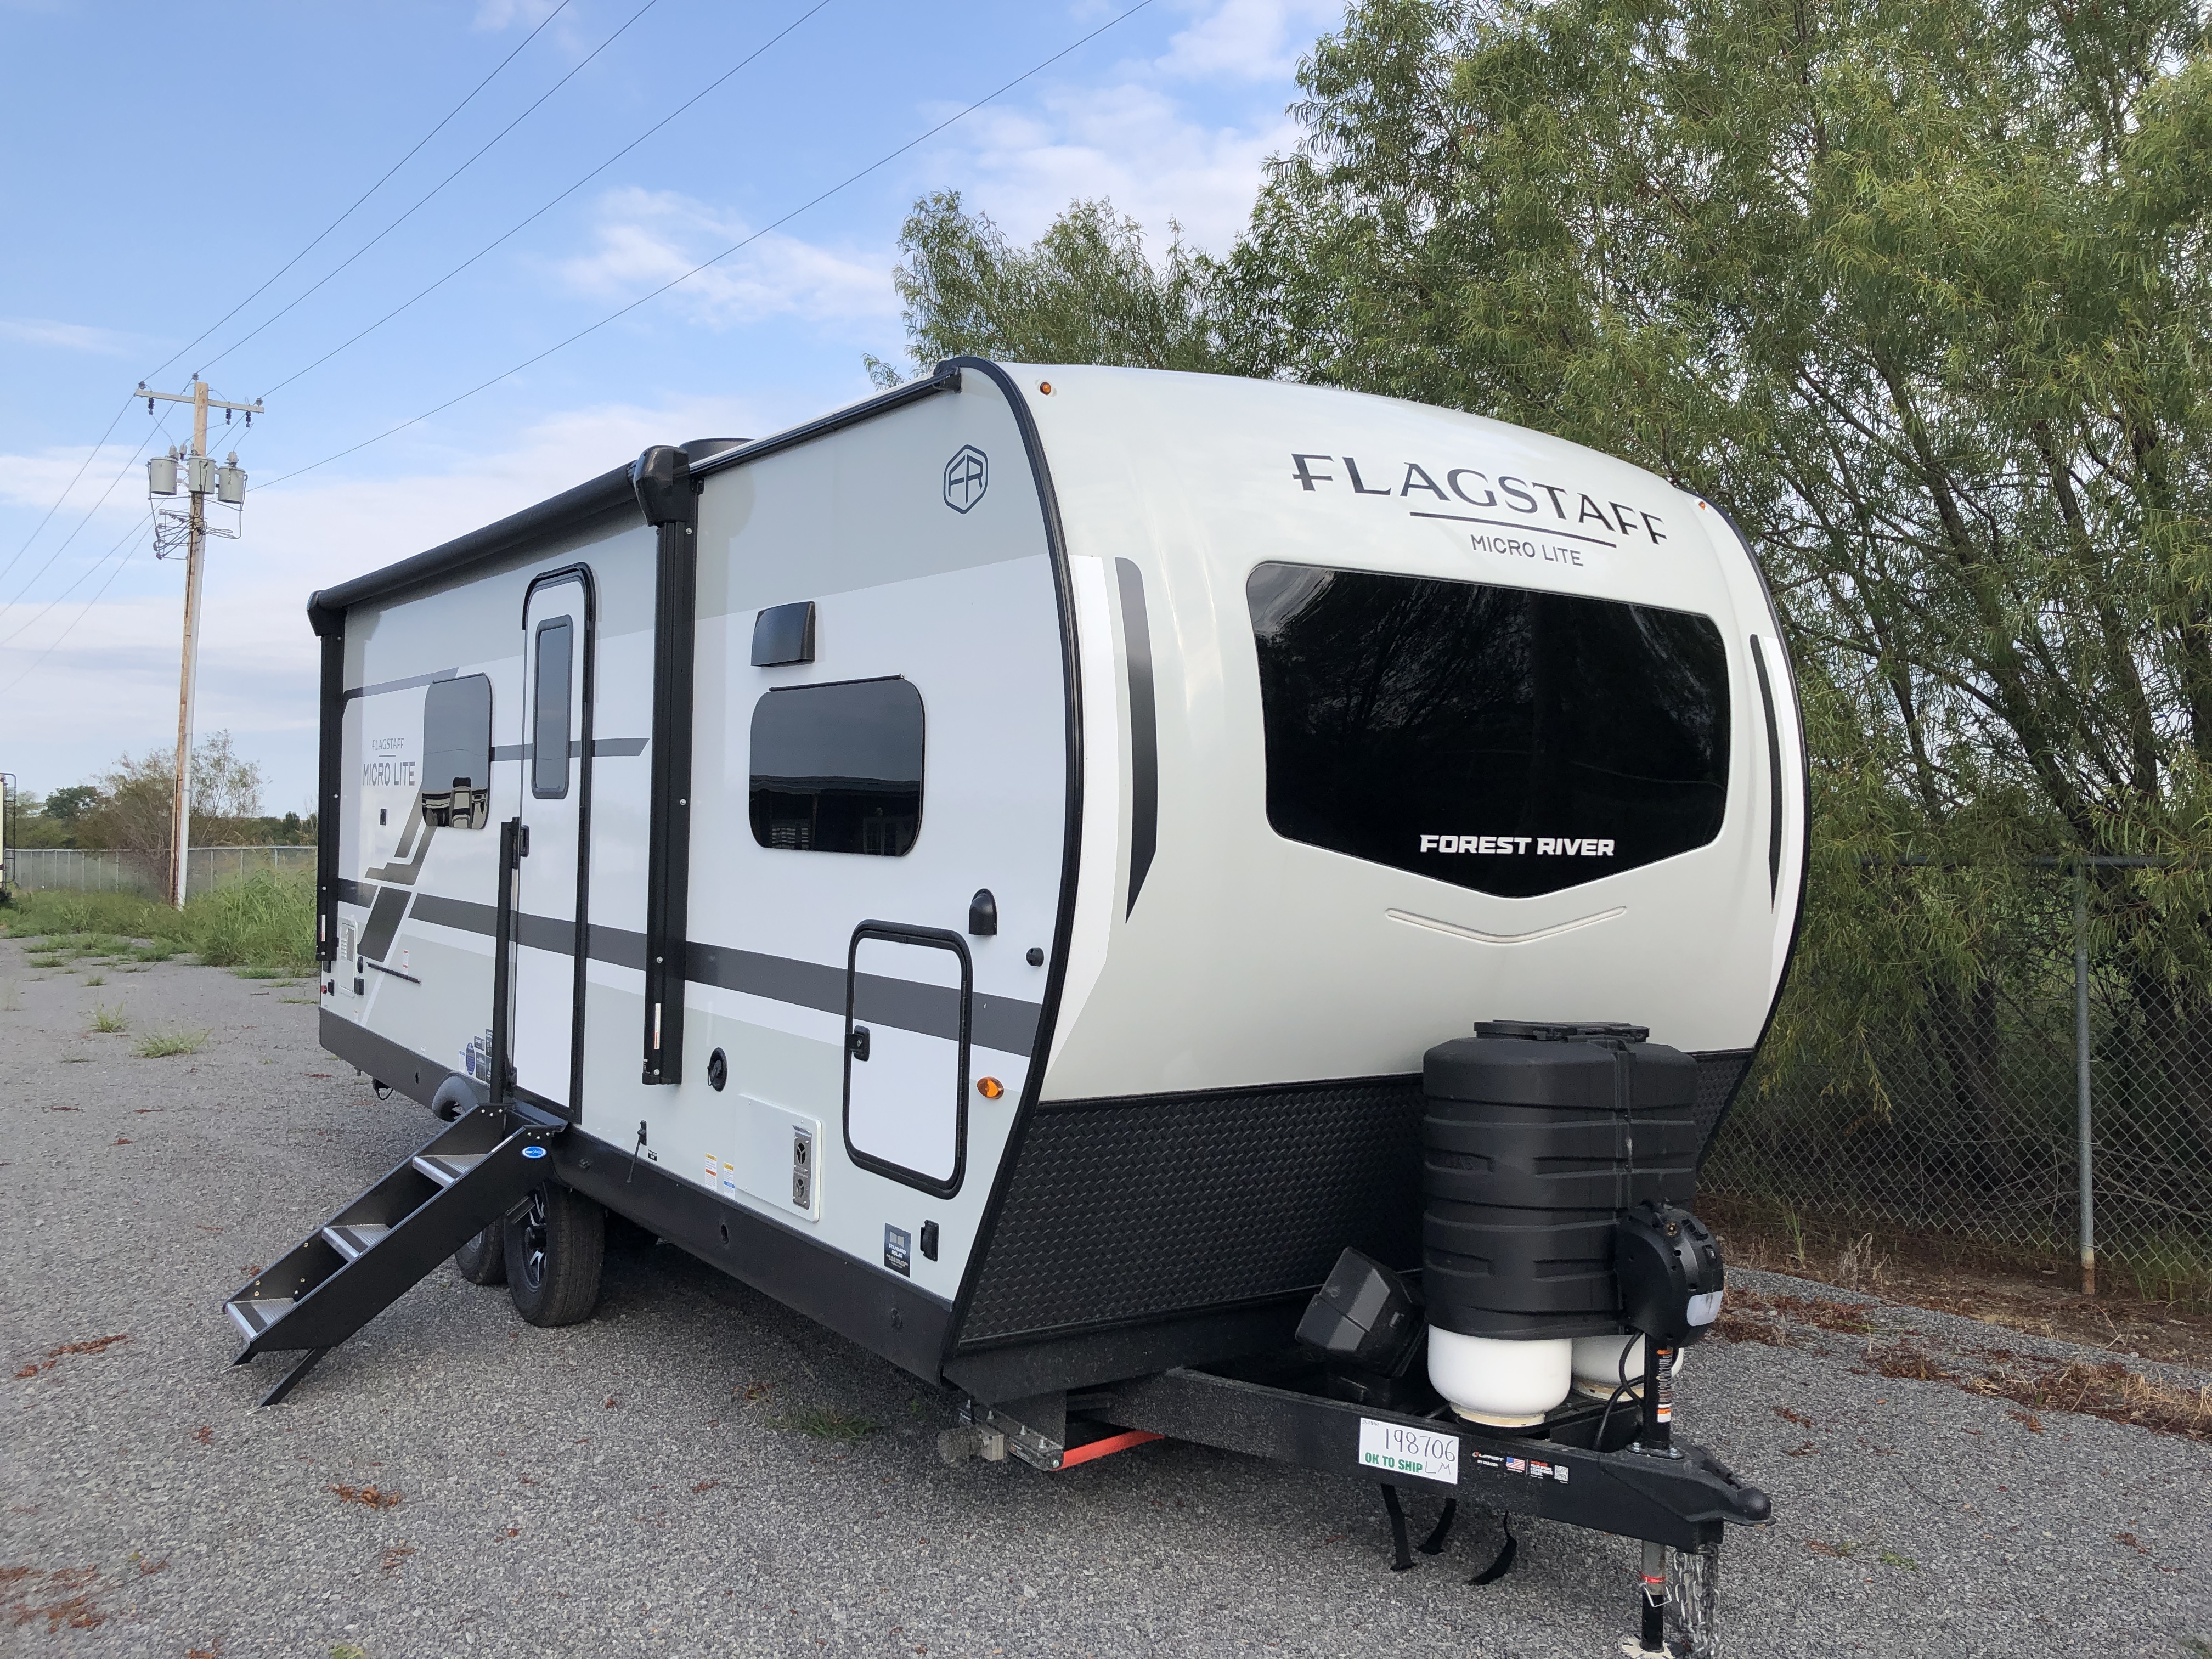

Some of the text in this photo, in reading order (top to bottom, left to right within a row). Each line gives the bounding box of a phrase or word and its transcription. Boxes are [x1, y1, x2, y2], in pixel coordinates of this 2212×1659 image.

[1291, 453, 1668, 546] FLAGSTAFF
[1470, 534, 1584, 567] MICRO LITE
[371, 737, 404, 751] FLAGSTAFF
[363, 761, 416, 786] MICRO LITE
[1420, 834, 1615, 856] FOREST RIVER
[1386, 1428, 1455, 1462] 198706
[1365, 1452, 1423, 1473] OK TO SHIP
